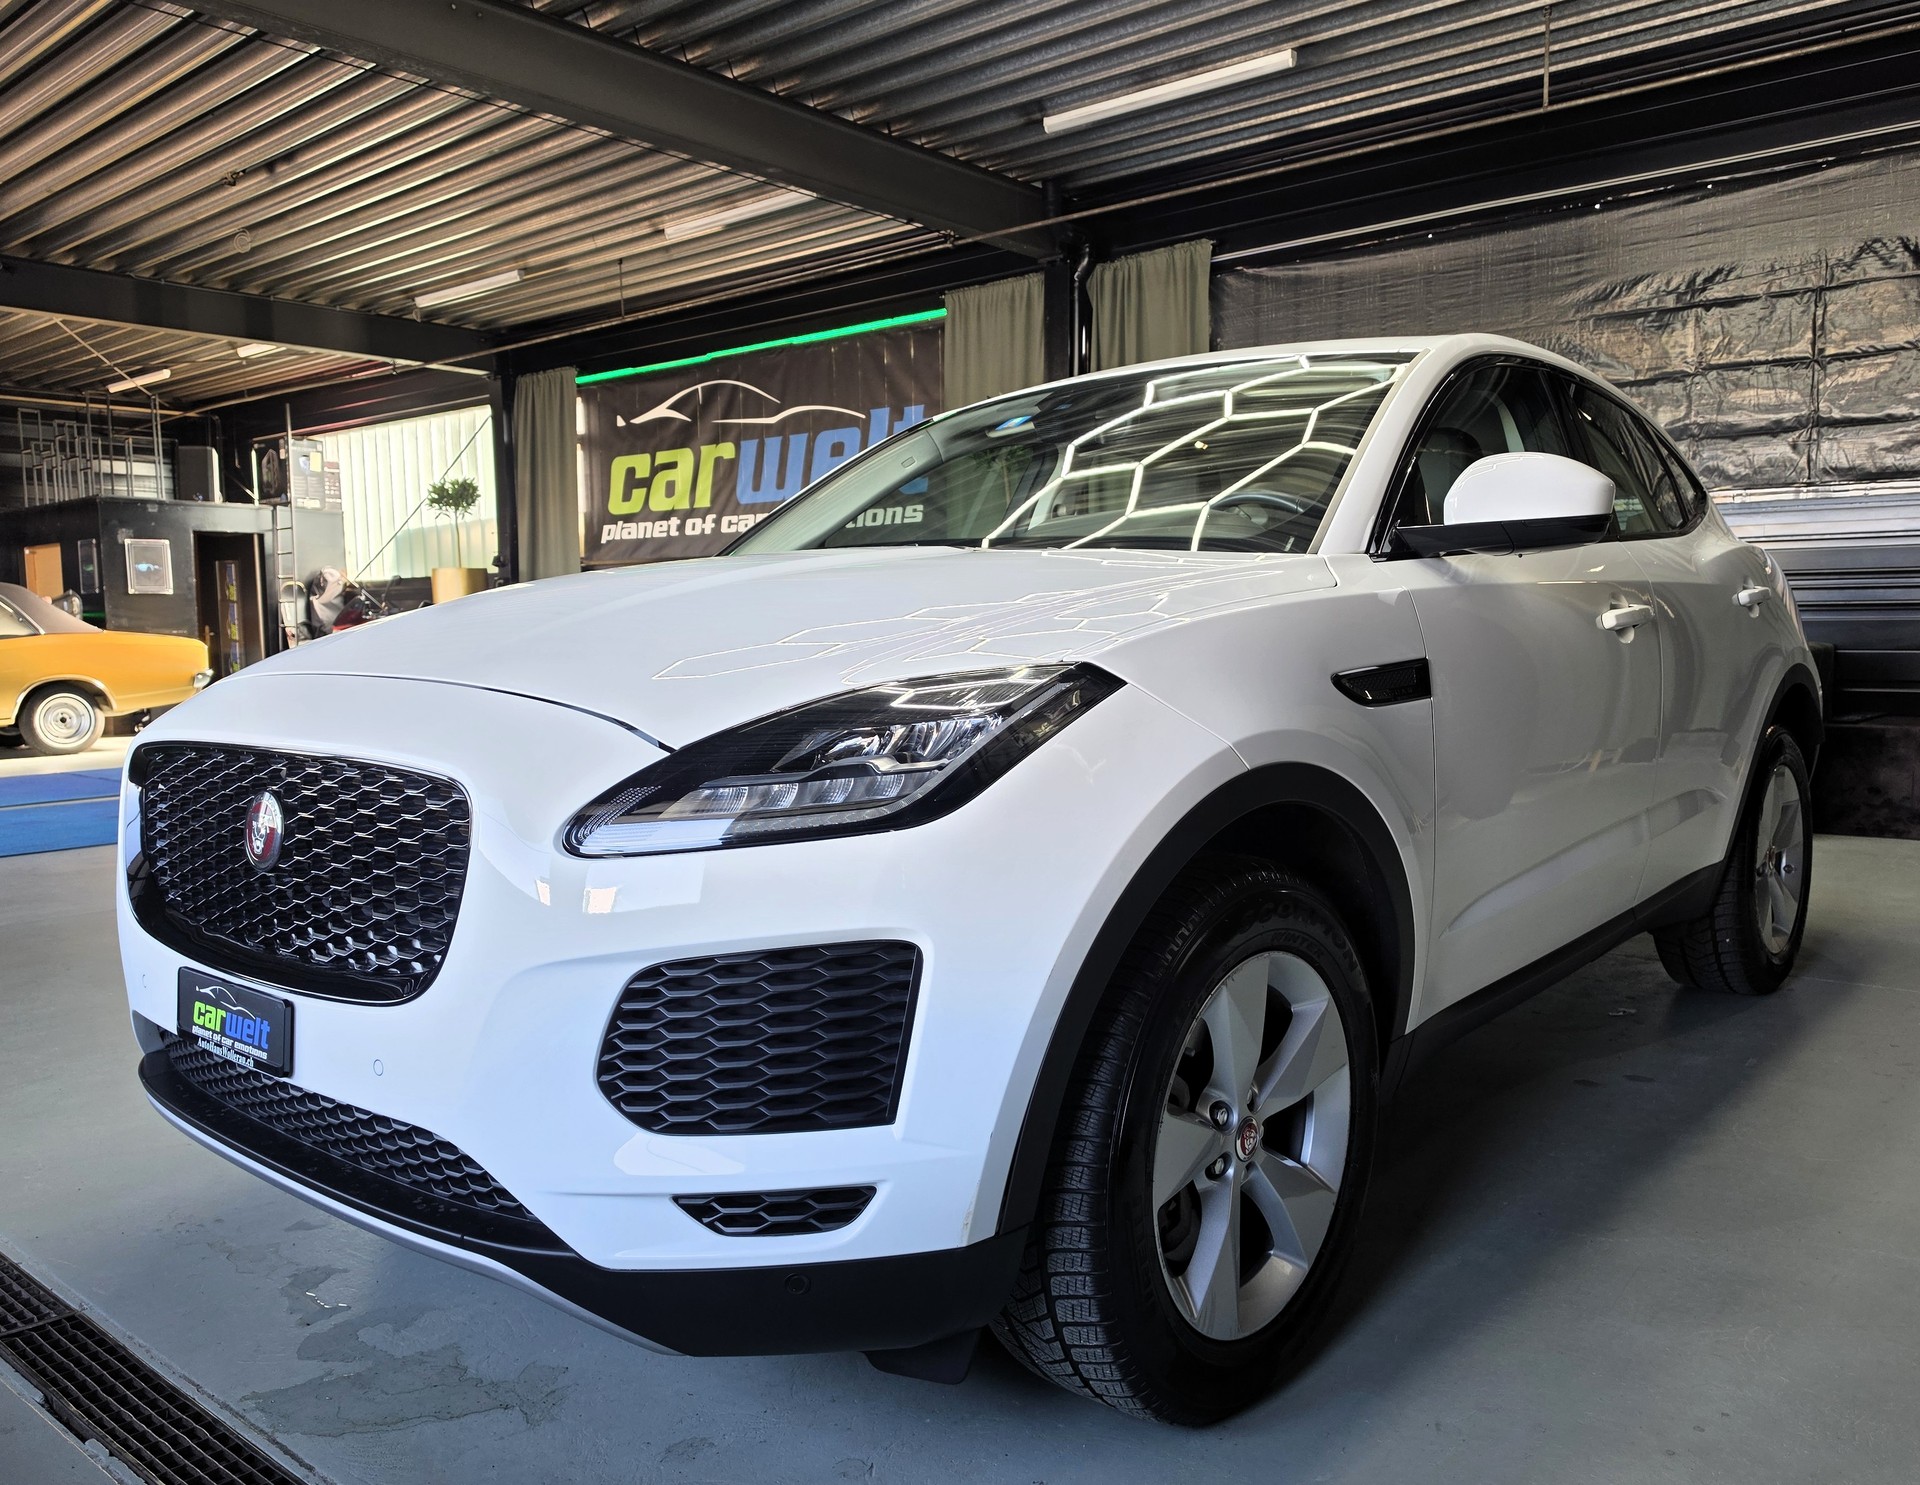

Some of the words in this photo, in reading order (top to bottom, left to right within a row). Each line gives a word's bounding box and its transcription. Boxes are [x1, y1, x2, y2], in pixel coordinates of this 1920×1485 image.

[600, 516, 680, 544] planet
[685, 513, 716, 536] of
[191, 1025, 213, 1039] planet
[212, 1032, 222, 1042] of
[221, 1036, 234, 1047] car
[234, 1041, 268, 1060] emotions
[193, 1001, 270, 1049] carwelt
